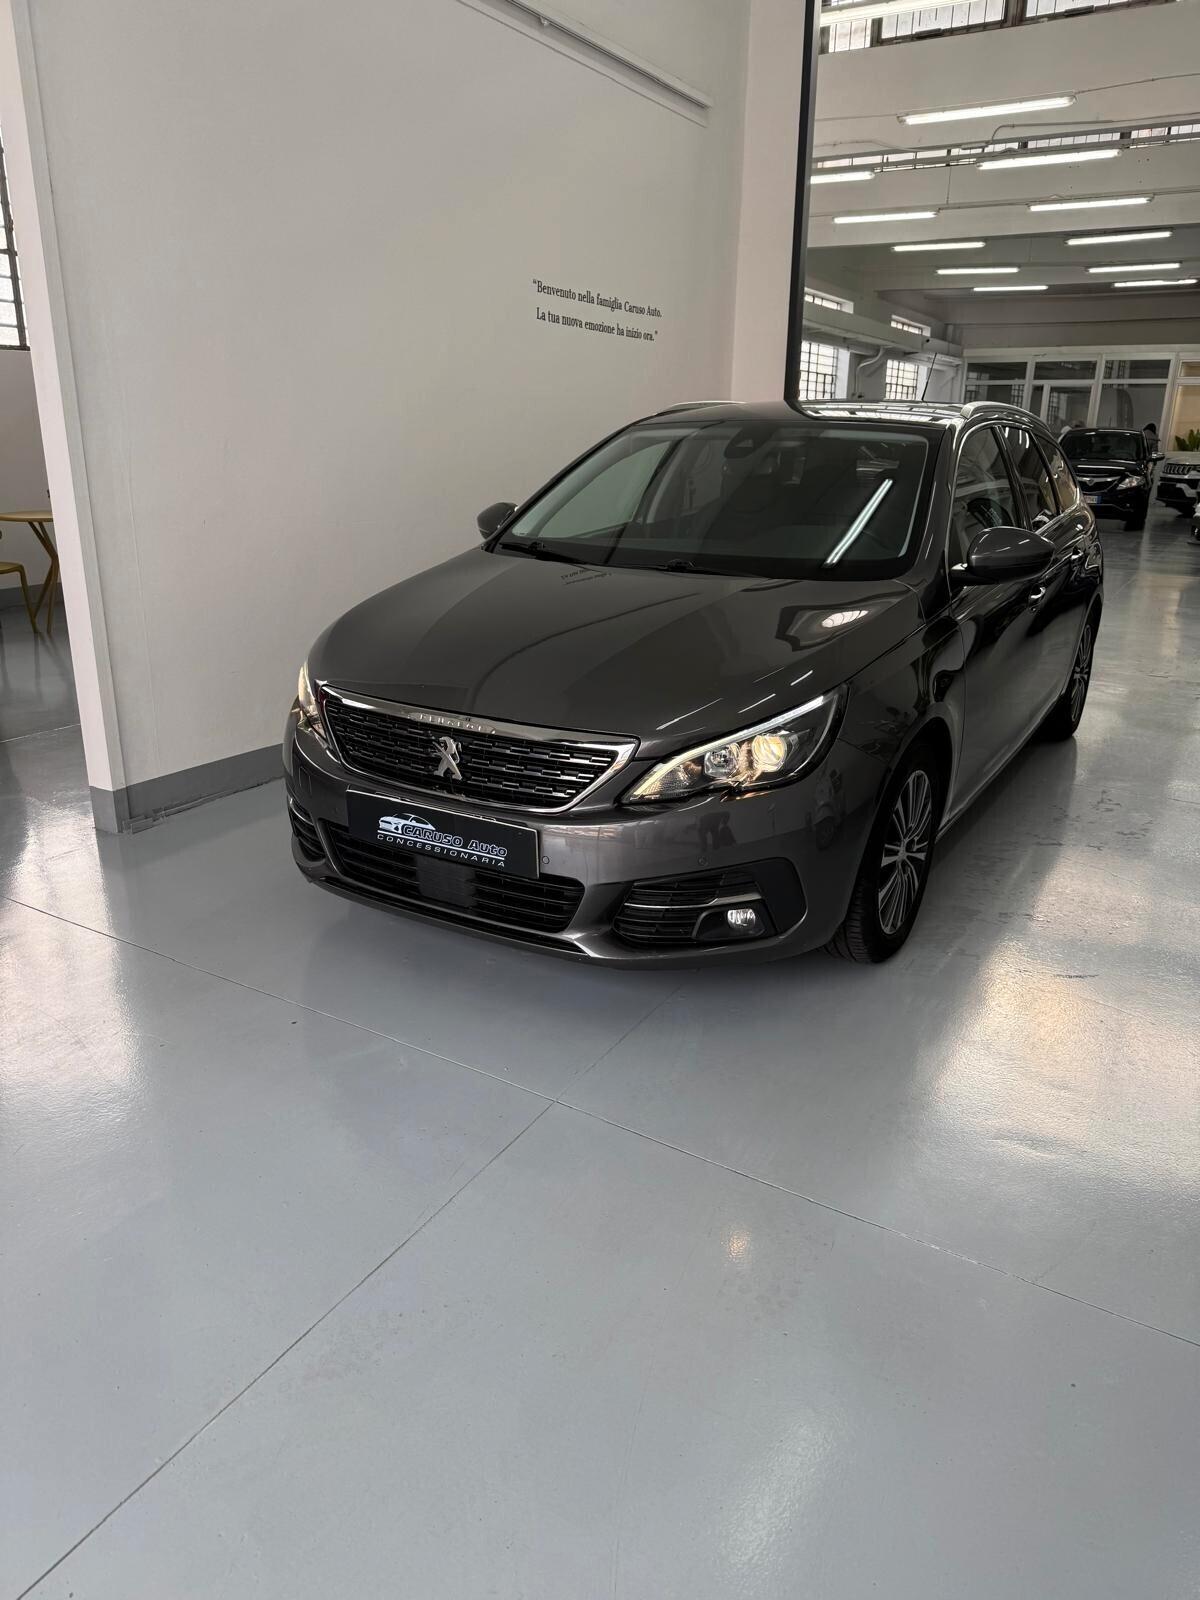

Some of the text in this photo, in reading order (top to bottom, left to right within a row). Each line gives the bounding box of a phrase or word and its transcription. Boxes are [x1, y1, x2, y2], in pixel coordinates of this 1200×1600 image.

[578, 290, 595, 304] nella
[596, 293, 622, 312] famiglia
[624, 301, 645, 315] Caruso
[646, 307, 662, 317] Auto.
[536, 307, 546, 321] La
[548, 310, 560, 323] tua
[561, 315, 583, 328] nuova
[584, 322, 615, 334] emozione
[616, 323, 624, 336] ha
[625, 327, 641, 339] inizio
[377, 834, 505, 867] CONCESSIONARIA
[403, 825, 508, 857] CARUSO Auto
